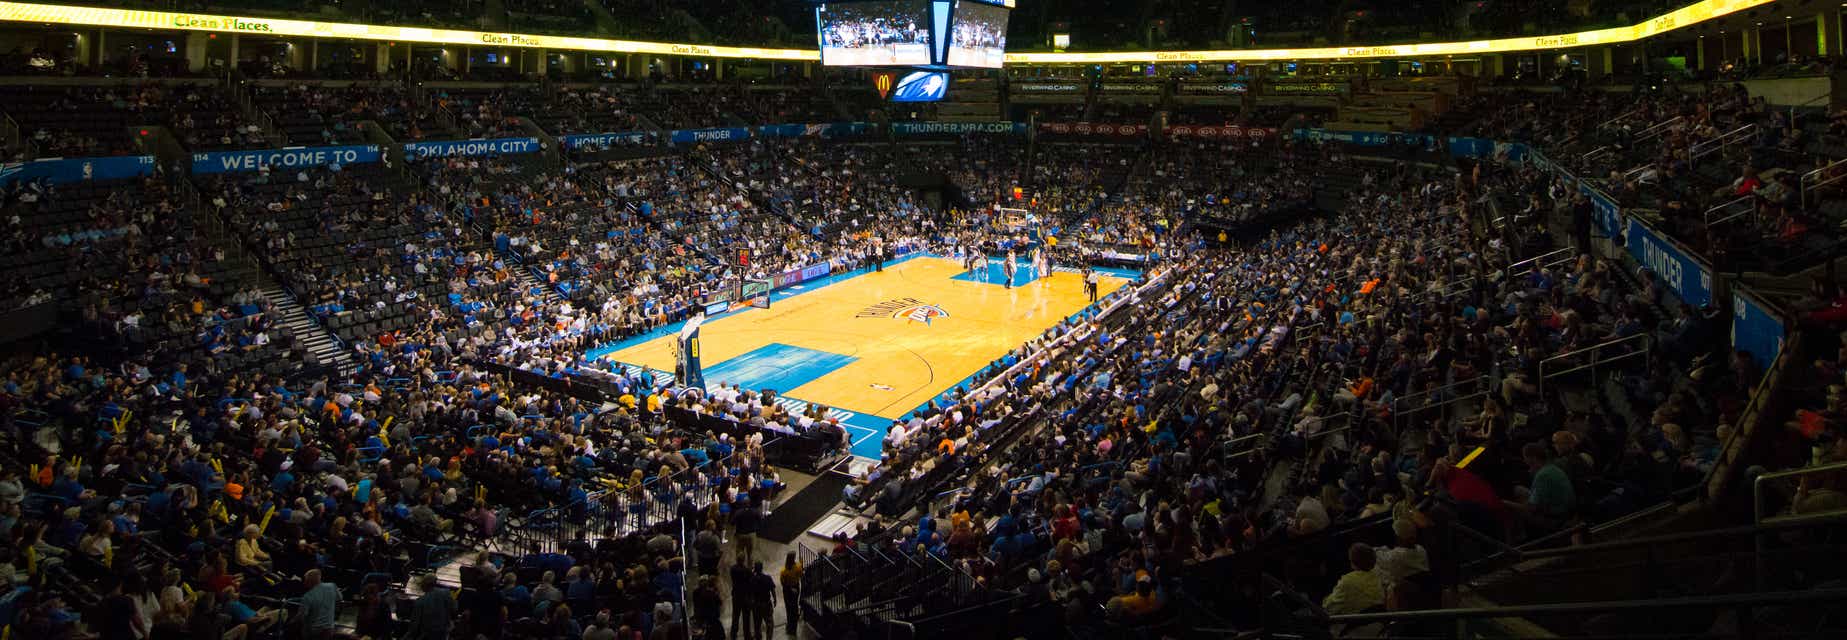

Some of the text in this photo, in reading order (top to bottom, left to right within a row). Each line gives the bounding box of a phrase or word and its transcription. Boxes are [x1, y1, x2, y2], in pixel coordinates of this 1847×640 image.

[174, 15, 273, 32] Clean Places.
[482, 33, 508, 44] Clean
[903, 122, 1013, 133] THUNDER.NBA.COM
[693, 129, 730, 141] THUNDER
[574, 136, 606, 148] HOME
[367, 145, 379, 153] 114
[417, 141, 530, 158] OKLAHOMA CITY
[138, 155, 154, 164] 113
[221, 150, 357, 170] WELCOME TO
[1642, 235, 1682, 296] THUNDER
